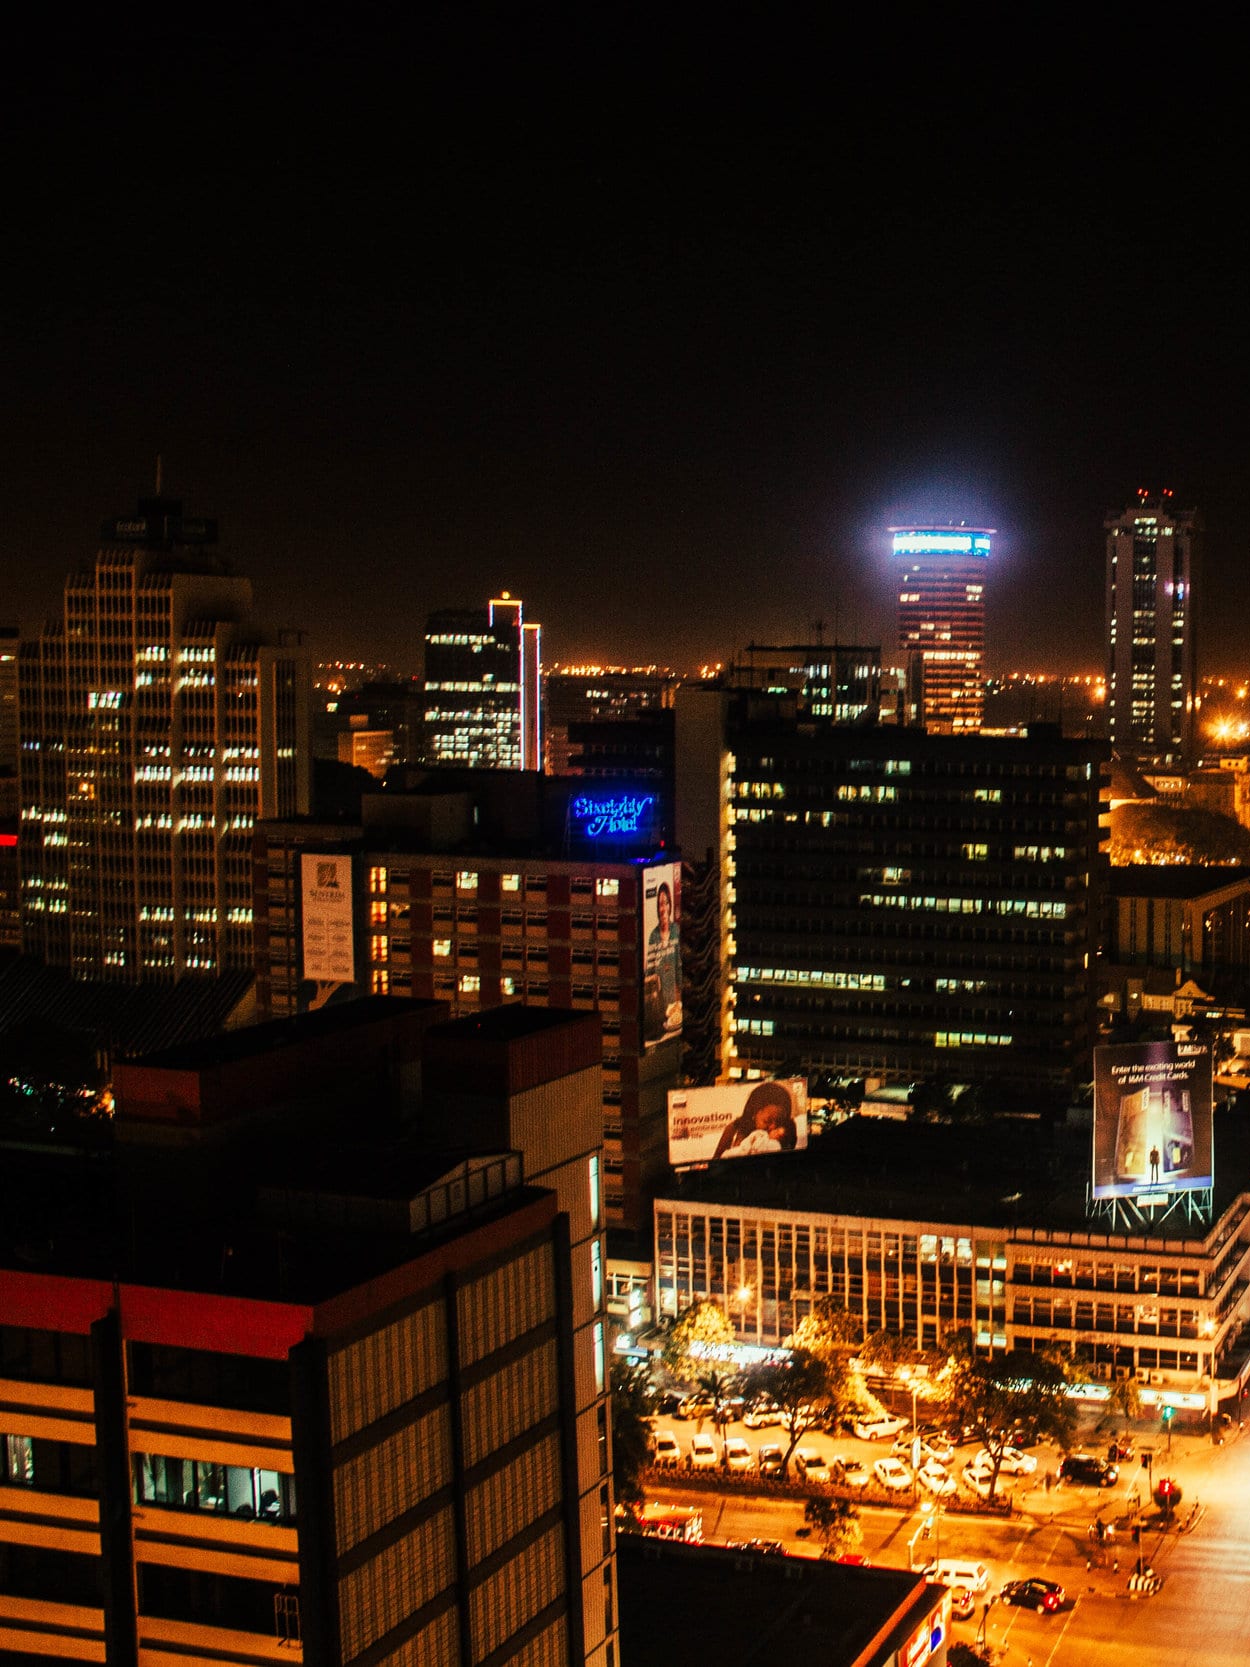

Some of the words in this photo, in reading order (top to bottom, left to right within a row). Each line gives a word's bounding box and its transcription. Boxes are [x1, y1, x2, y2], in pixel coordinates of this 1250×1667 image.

[1111, 1065, 1131, 1075] Enter
[1132, 1063, 1144, 1073] the
[1145, 1061, 1174, 1071] exciting
[1175, 1060, 1196, 1069] world
[1118, 1075, 1127, 1085] of
[1144, 1072, 1166, 1082] Credit
[673, 1112, 732, 1126] Innovation
